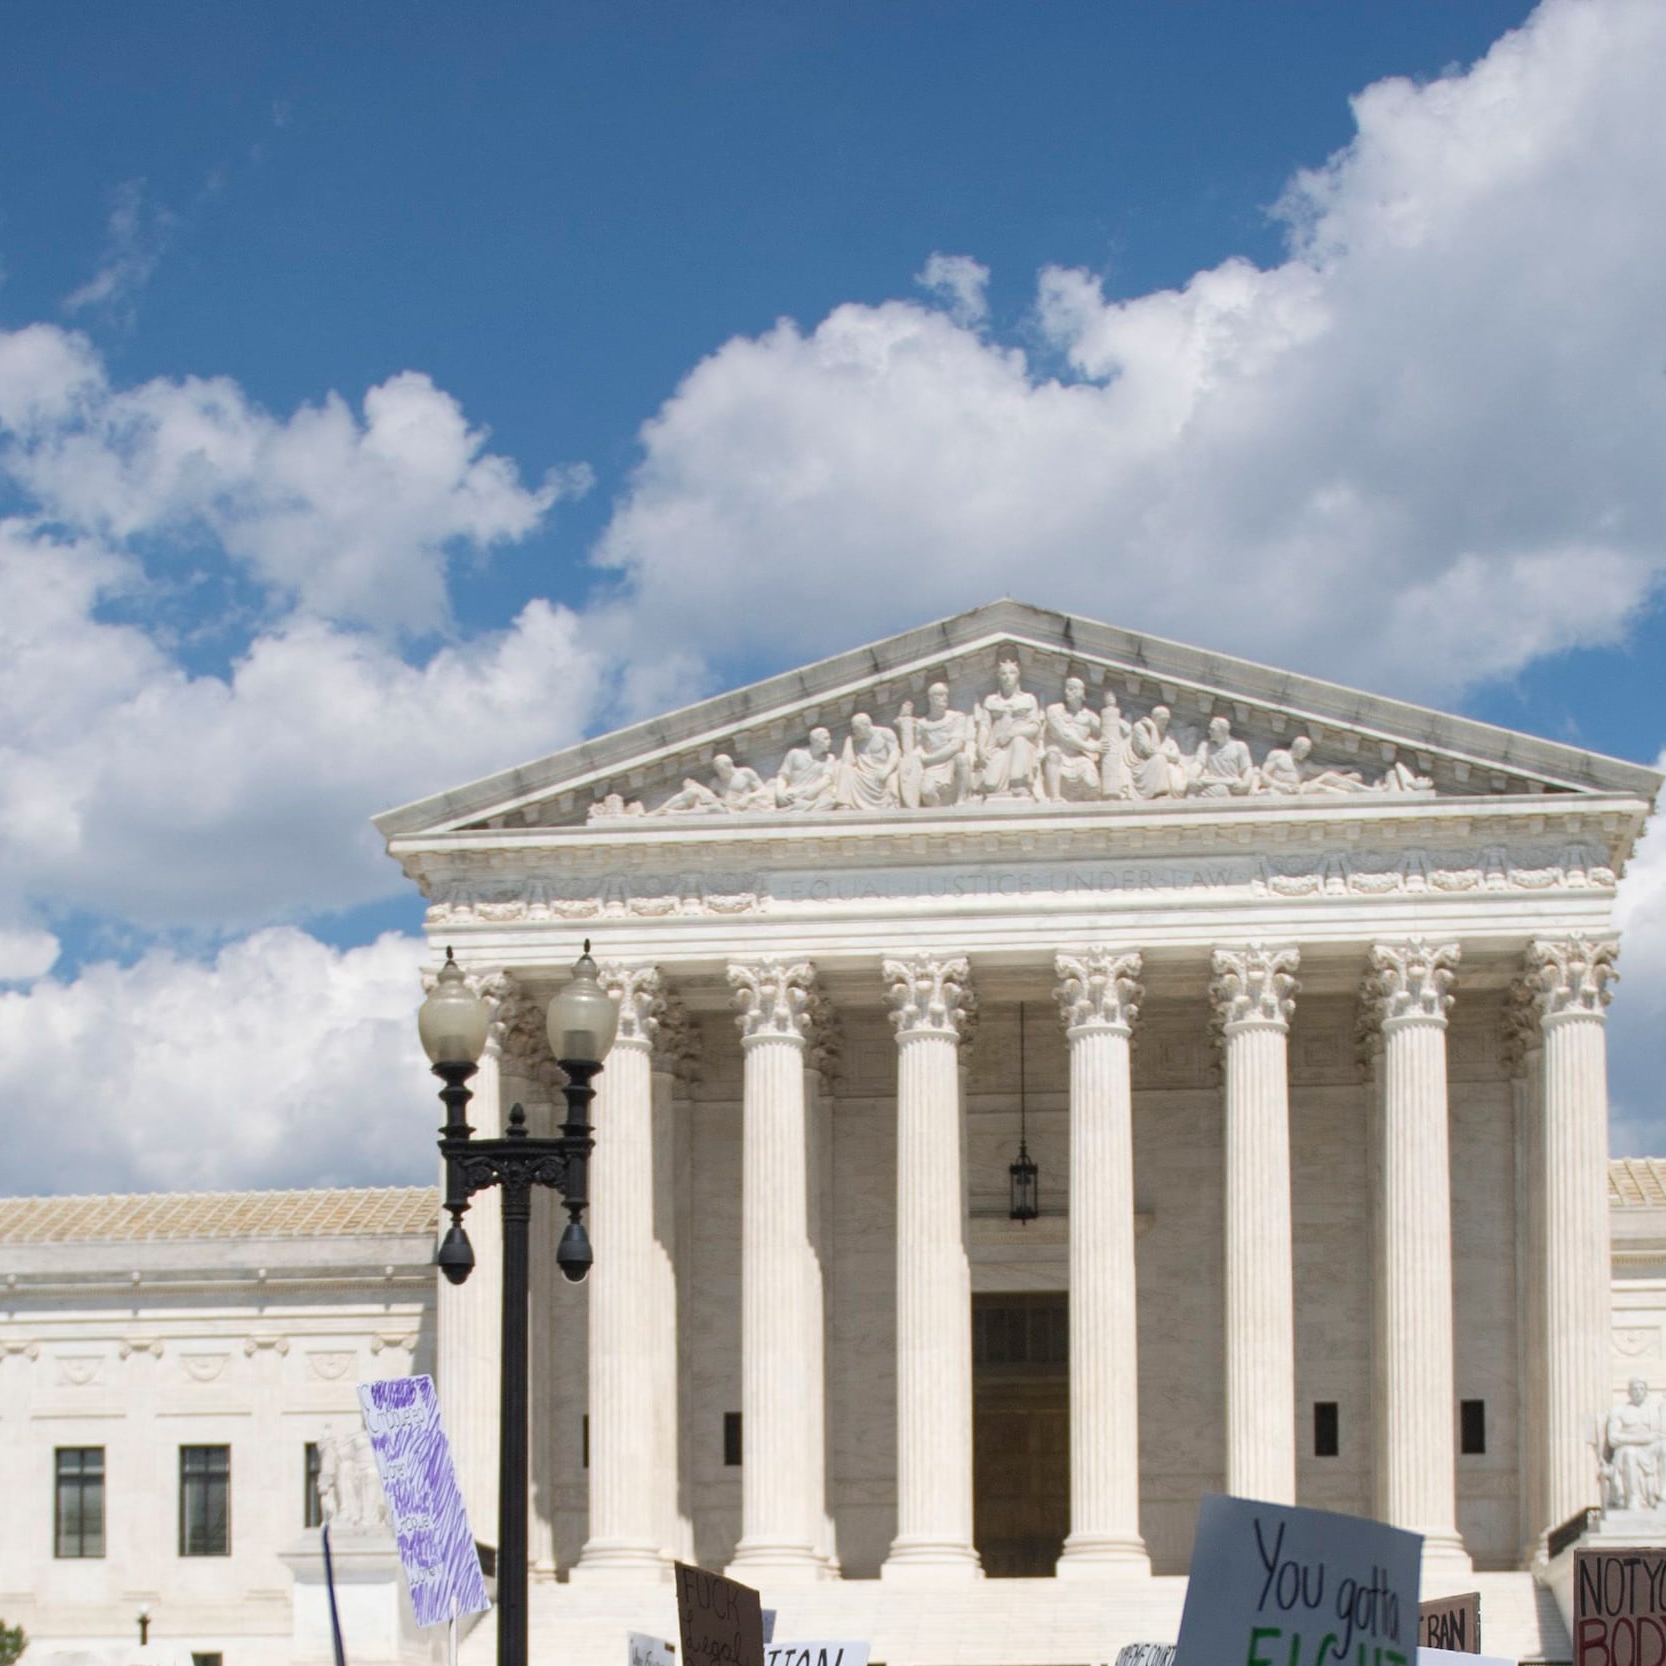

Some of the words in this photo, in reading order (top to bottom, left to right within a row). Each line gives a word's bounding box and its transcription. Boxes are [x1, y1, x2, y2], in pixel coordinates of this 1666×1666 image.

[908, 872, 1033, 897] JUSTICE
[1050, 869, 1157, 893] UNDER
[1172, 866, 1233, 889] LAW
[683, 1567, 740, 1626] FUCK
[1253, 1518, 1325, 1612] You
[1335, 1565, 1401, 1660] gotta
[1579, 1557, 1640, 1617] NOT
[1427, 1608, 1465, 1651] BAN
